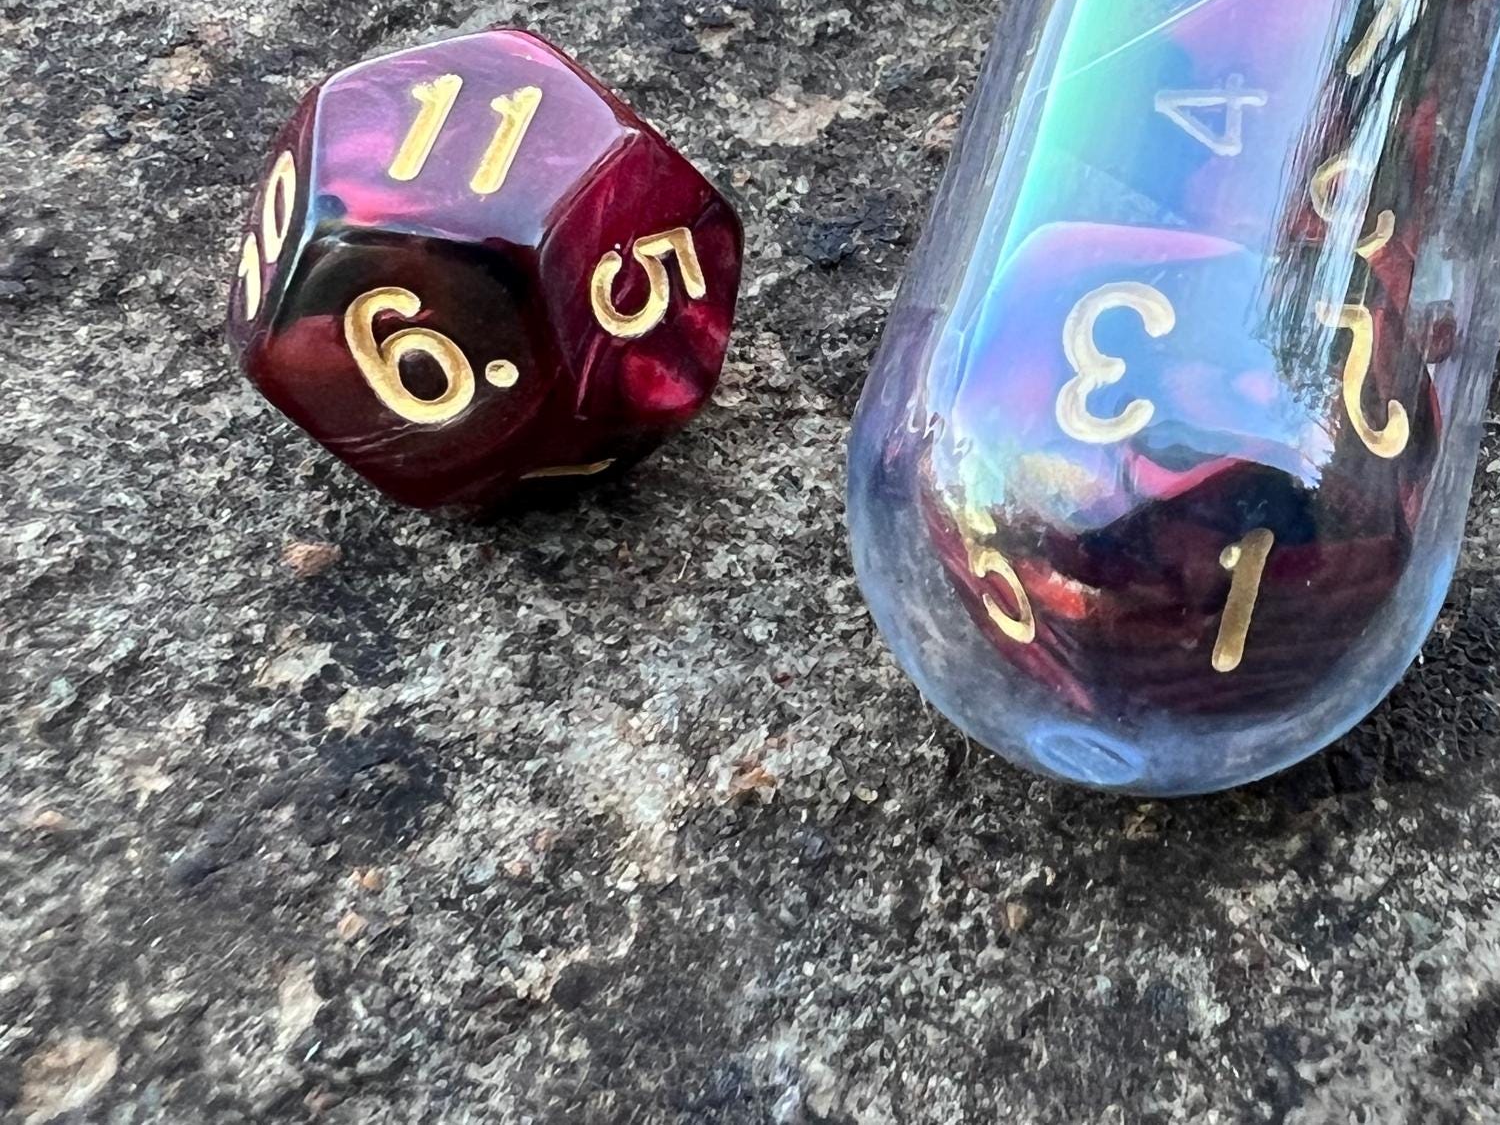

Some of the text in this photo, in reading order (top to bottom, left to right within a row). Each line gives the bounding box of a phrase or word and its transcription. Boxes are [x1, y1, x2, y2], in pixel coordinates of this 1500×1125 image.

[387, 72, 543, 195] 11
[1154, 73, 1269, 157] 4
[237, 149, 297, 321] 10
[590, 226, 706, 339] 5
[1053, 280, 1177, 444] 3
[1210, 527, 1275, 673] 1
